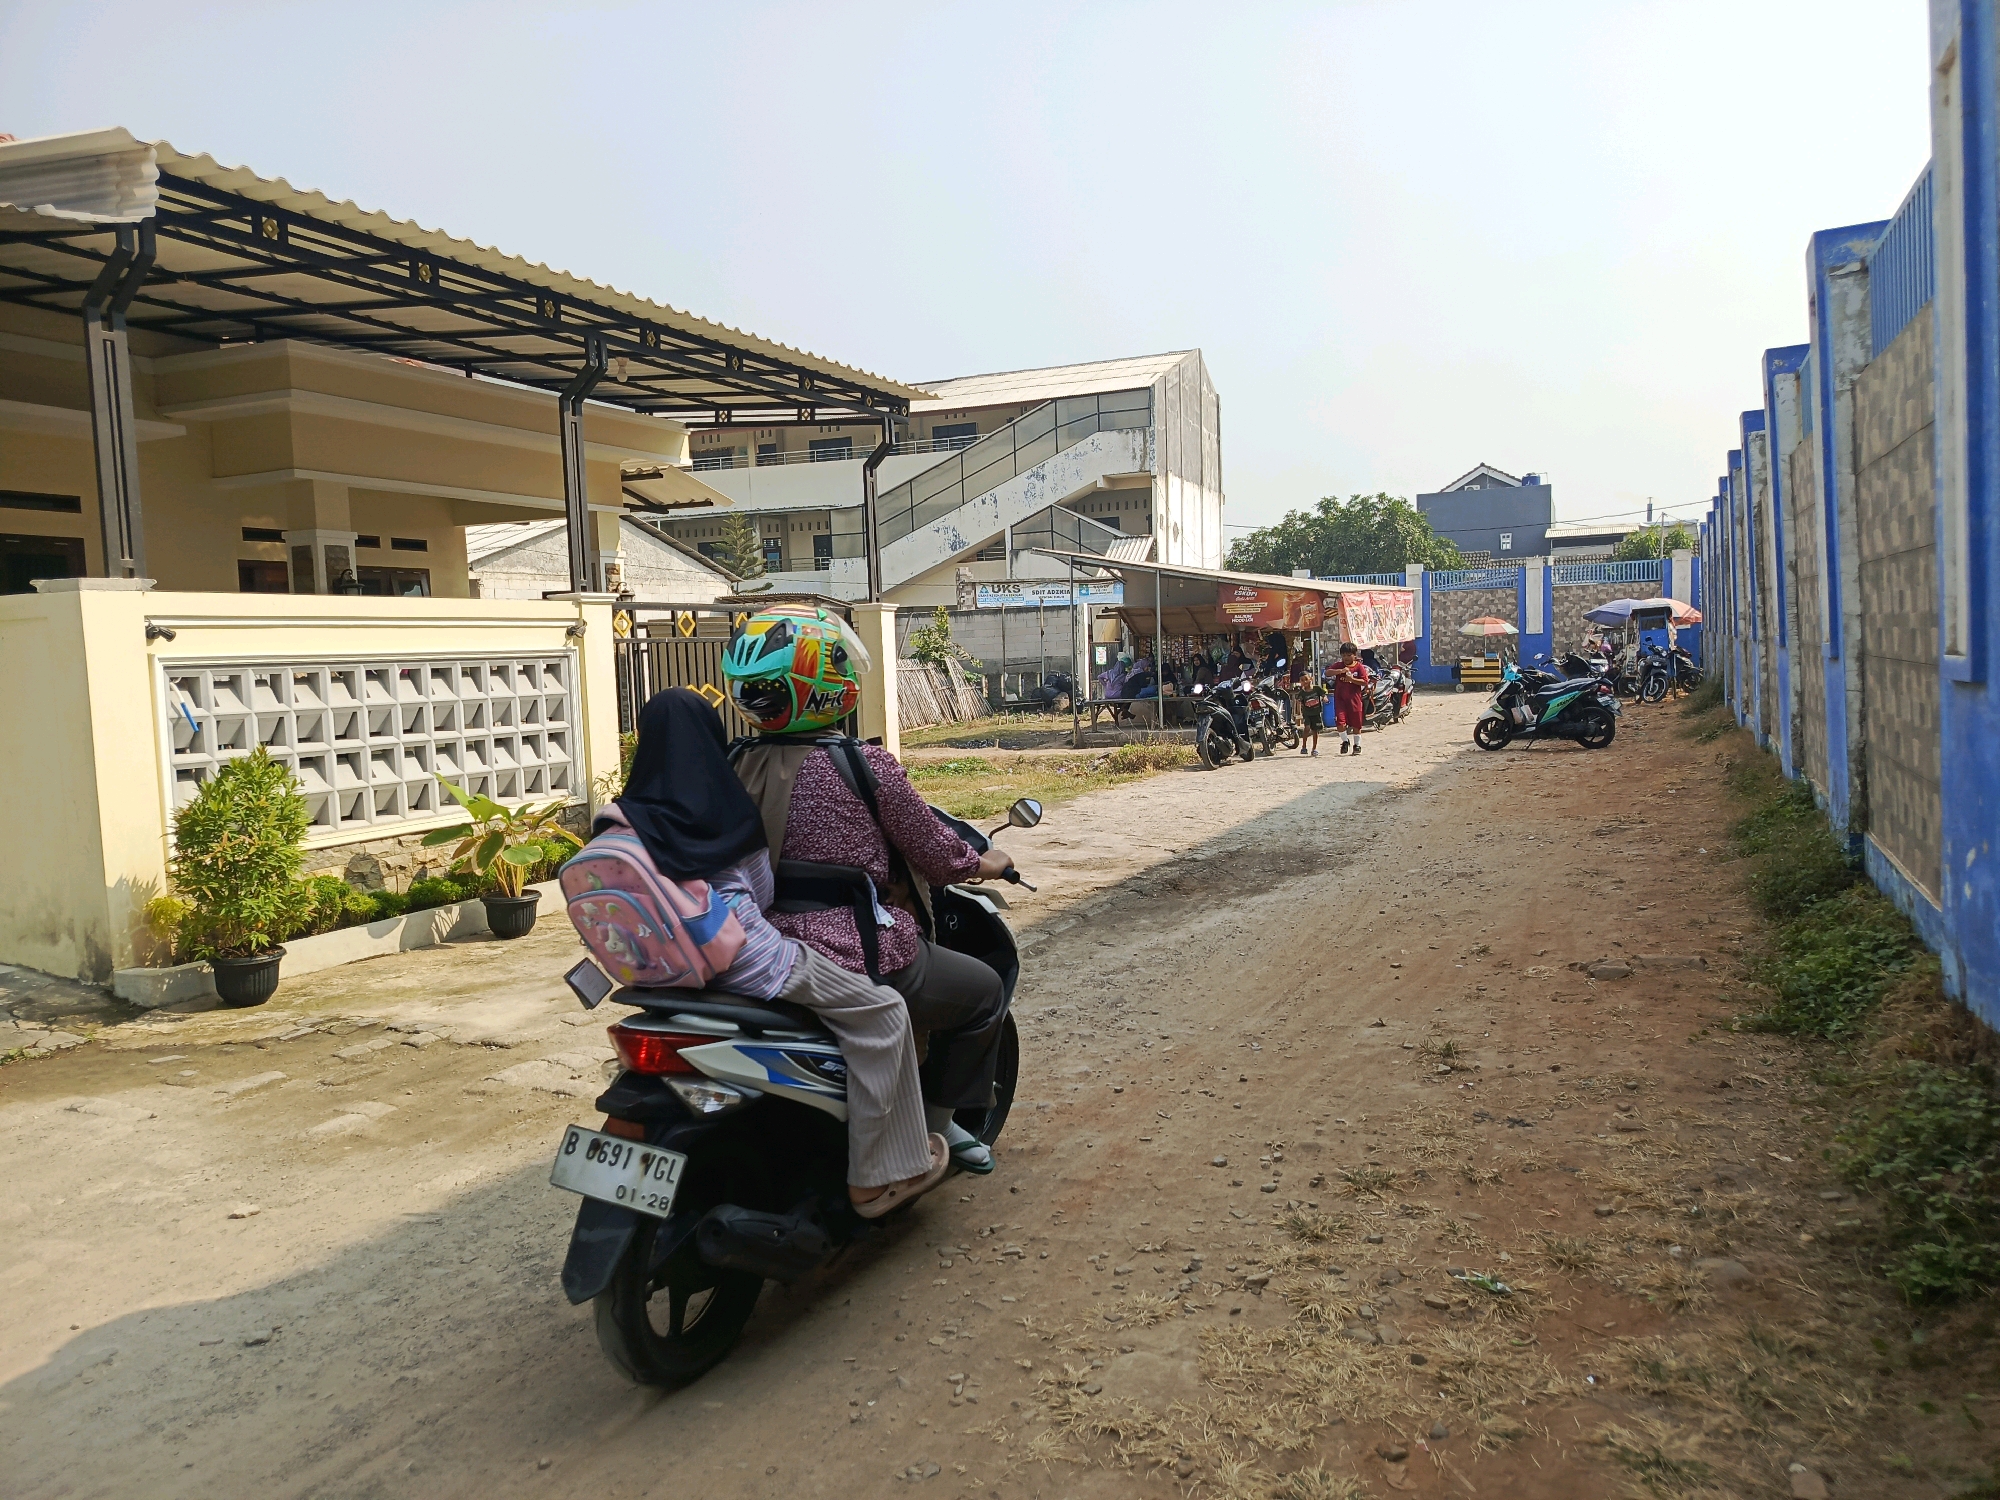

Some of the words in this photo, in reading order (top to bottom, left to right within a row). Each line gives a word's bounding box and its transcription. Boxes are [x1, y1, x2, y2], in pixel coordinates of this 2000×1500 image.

[991, 584, 1021, 593] UKS
[803, 685, 847, 716] NHK
[564, 1131, 579, 1156] B
[640, 1152, 677, 1184] VGL
